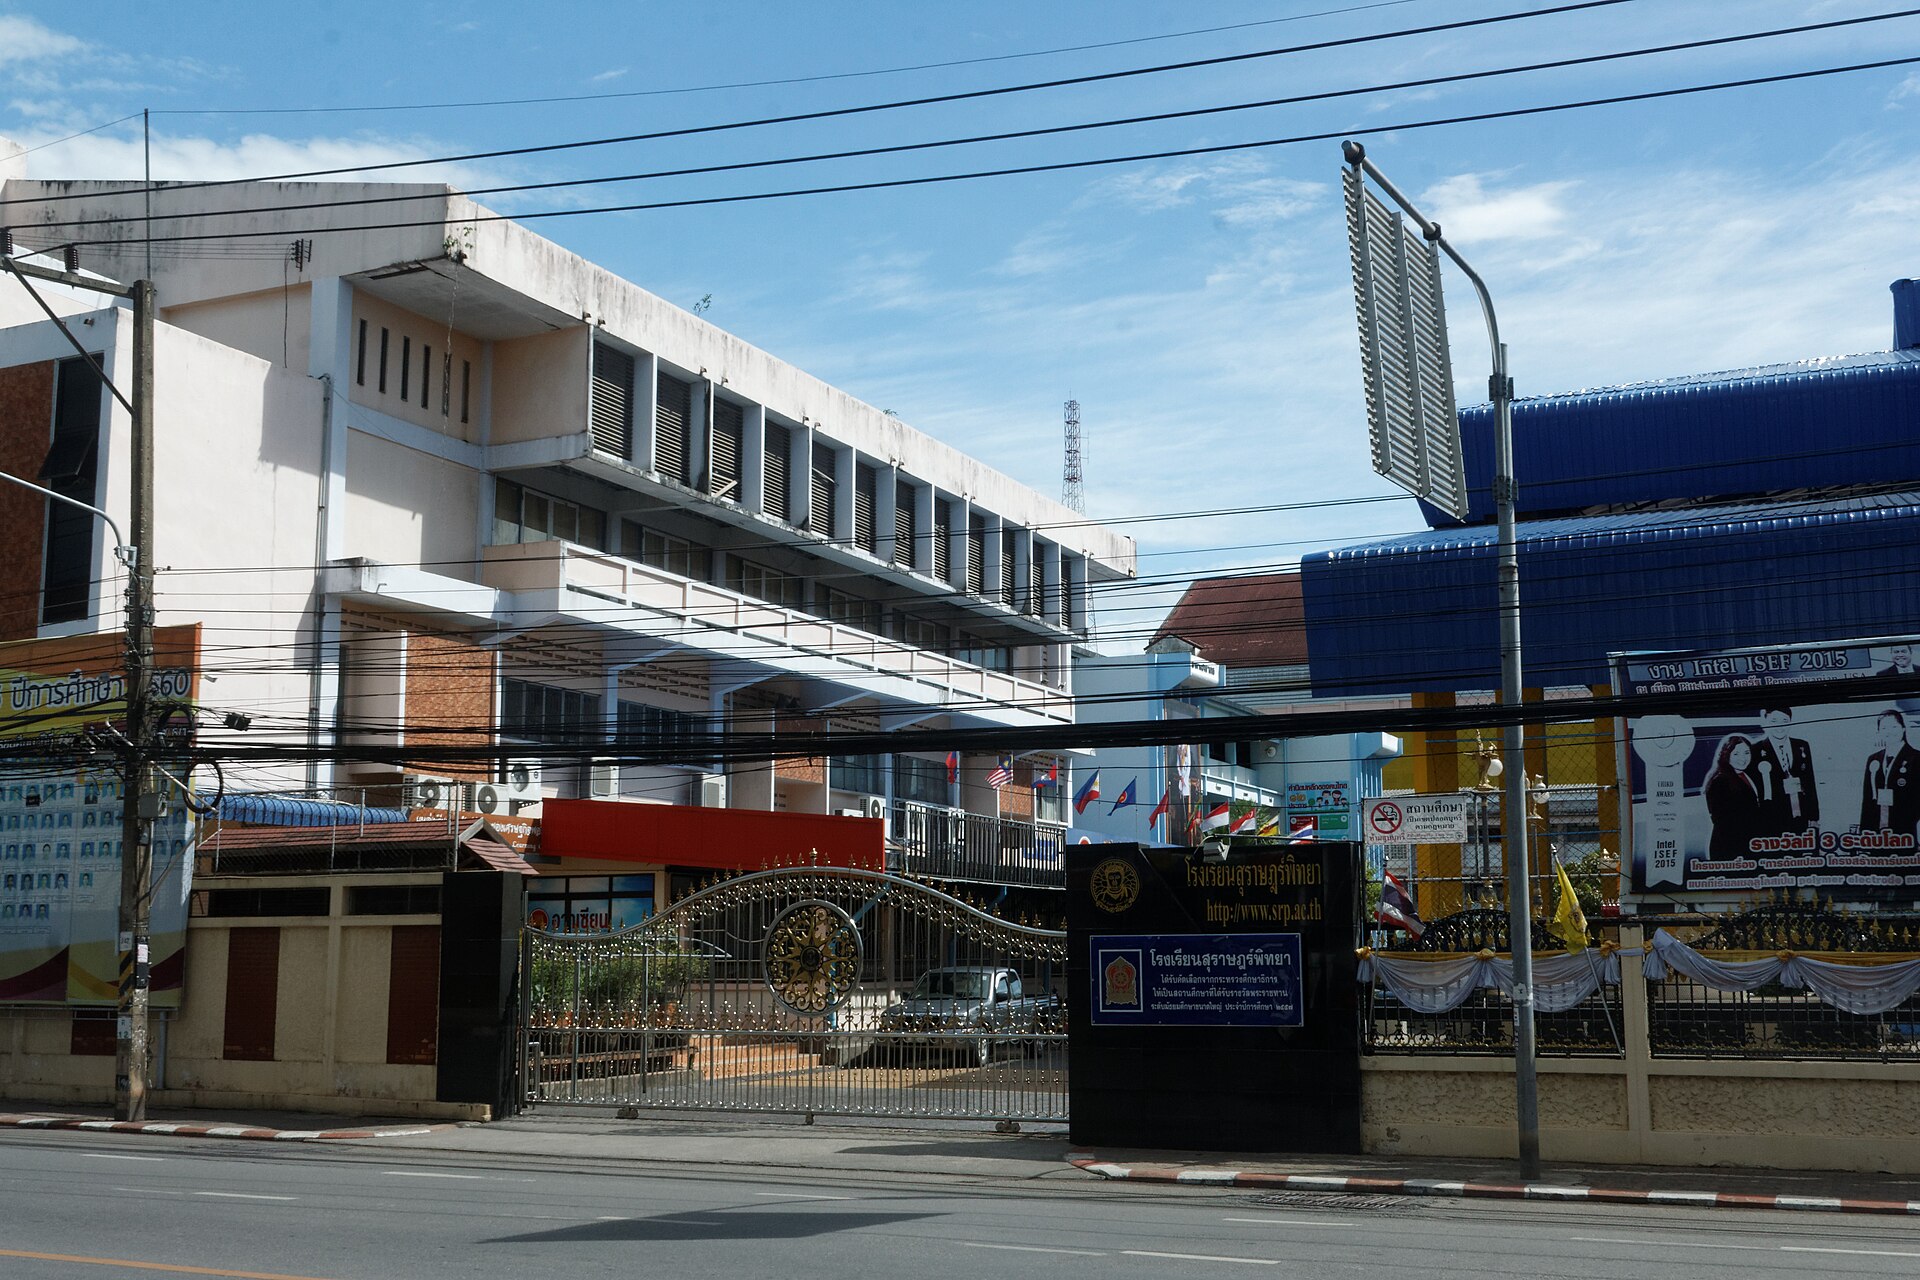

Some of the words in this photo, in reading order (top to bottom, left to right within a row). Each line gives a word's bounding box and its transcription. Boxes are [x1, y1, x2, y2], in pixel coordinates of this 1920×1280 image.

[1648, 661, 1684, 678] งาน
[1693, 656, 1737, 676] Intel
[1746, 653, 1791, 672] ISEF
[1800, 649, 1848, 669] 2015
[11, 670, 125, 710] ปีการศึกษา
[1406, 800, 1463, 814] สถานศึกษา
[1656, 839, 1676, 849] Intel
[1750, 829, 1814, 851] รางวัลที่
[1822, 834, 1834, 848] 3
[1842, 831, 1913, 849] ระดับโลก
[1654, 849, 1678, 859] ISEF
[1654, 859, 1676, 868] 2015
[1691, 857, 1756, 871] โครงงานเรื่อง
[1206, 897, 1322, 927] http://www.srp.ac.th
[1150, 948, 1292, 973] โรงเรียนสุราษฎร์พิทยา
